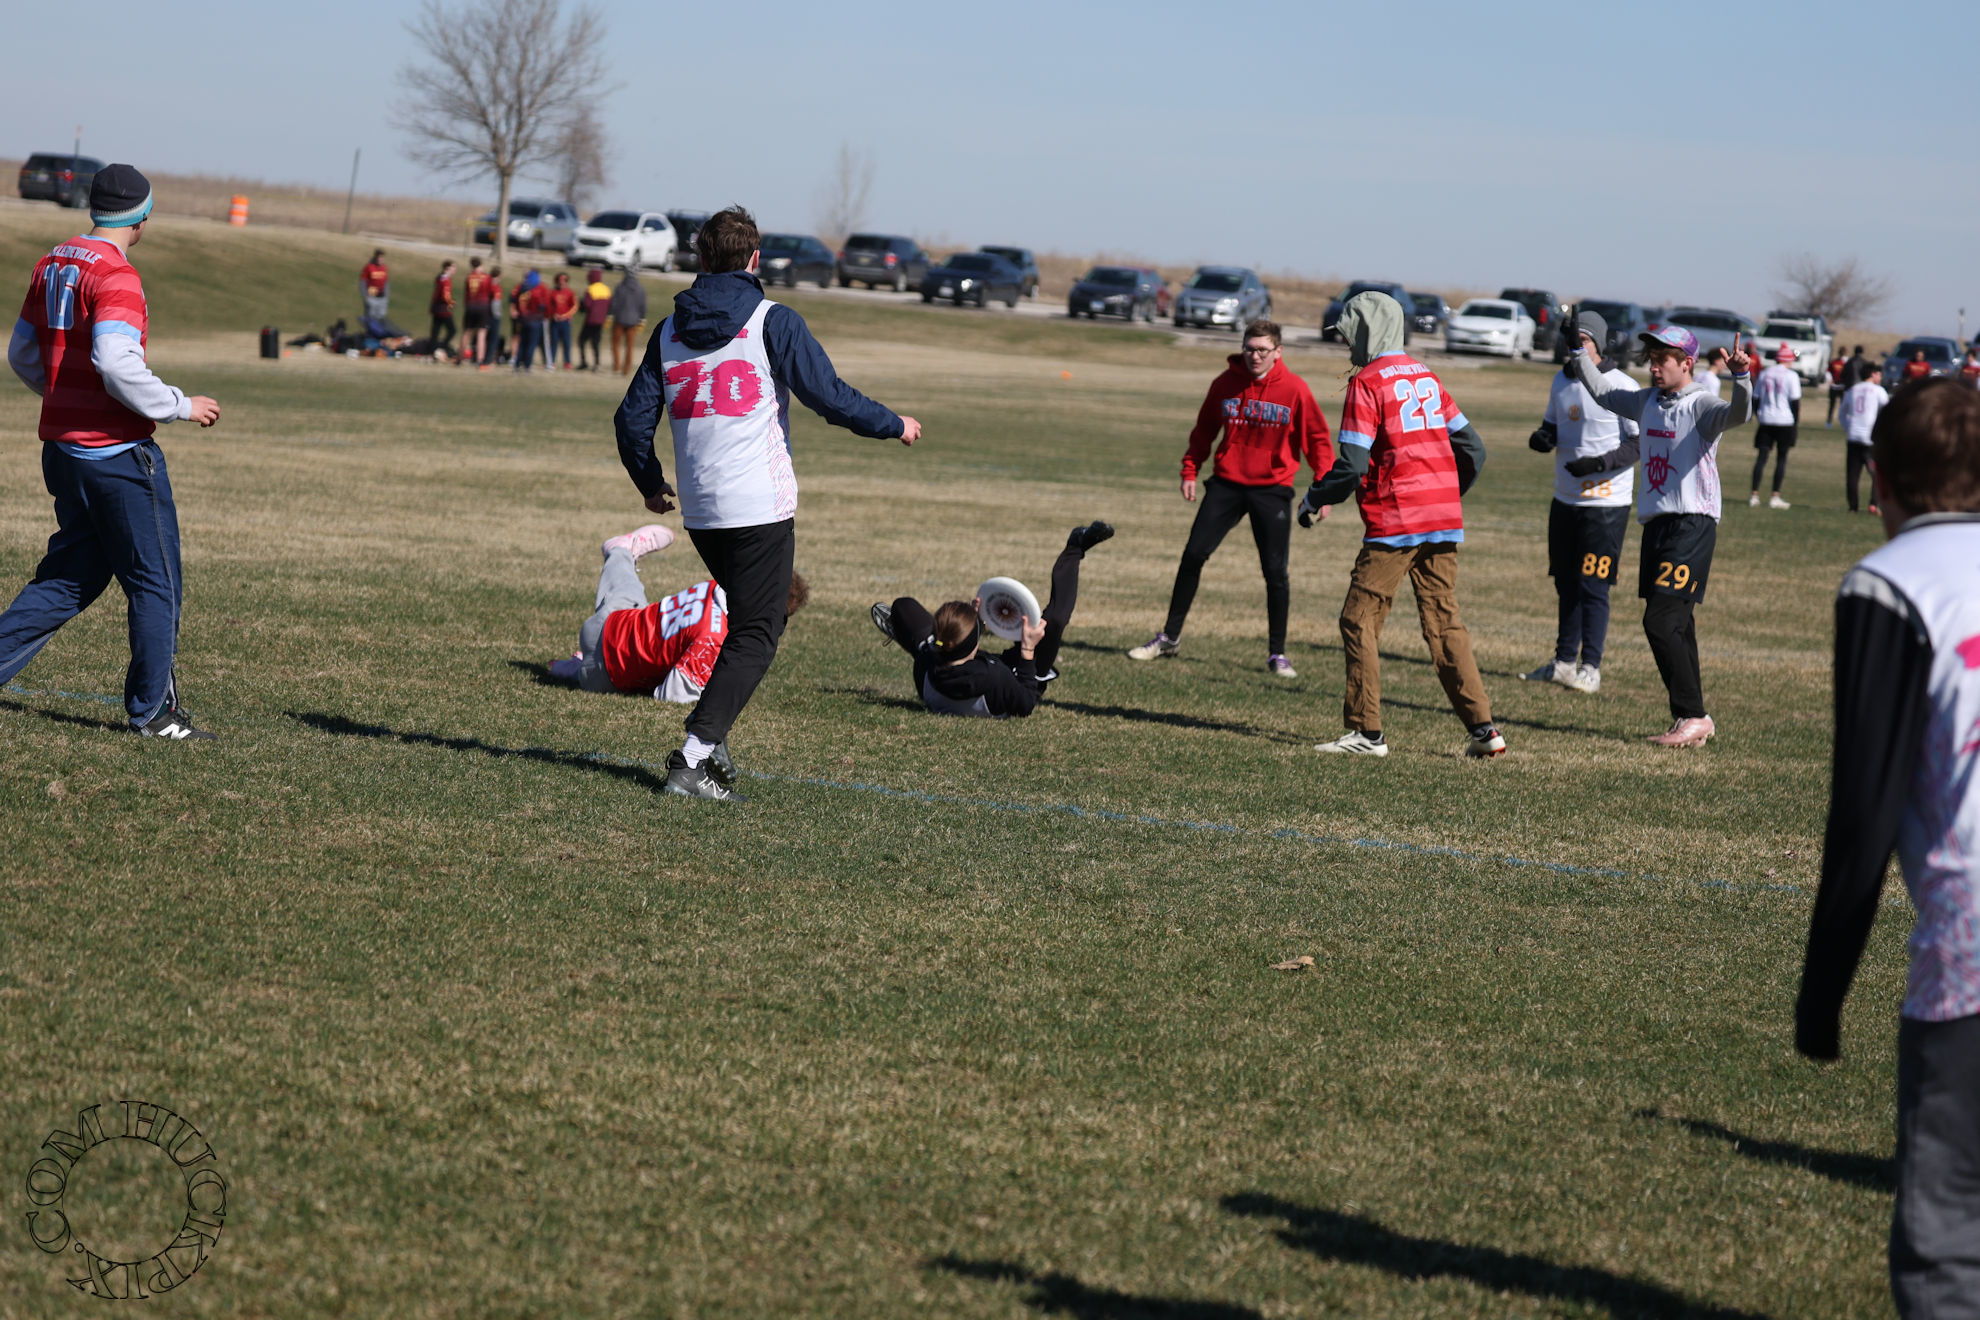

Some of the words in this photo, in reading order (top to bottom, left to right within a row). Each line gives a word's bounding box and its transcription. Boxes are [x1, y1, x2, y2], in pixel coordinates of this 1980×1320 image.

[663, 359, 763, 419] 20
[1393, 377, 1446, 433] 22
[1581, 479, 1611, 497] 88
[1582, 552, 1612, 579] 88
[1655, 561, 1690, 590] 29
